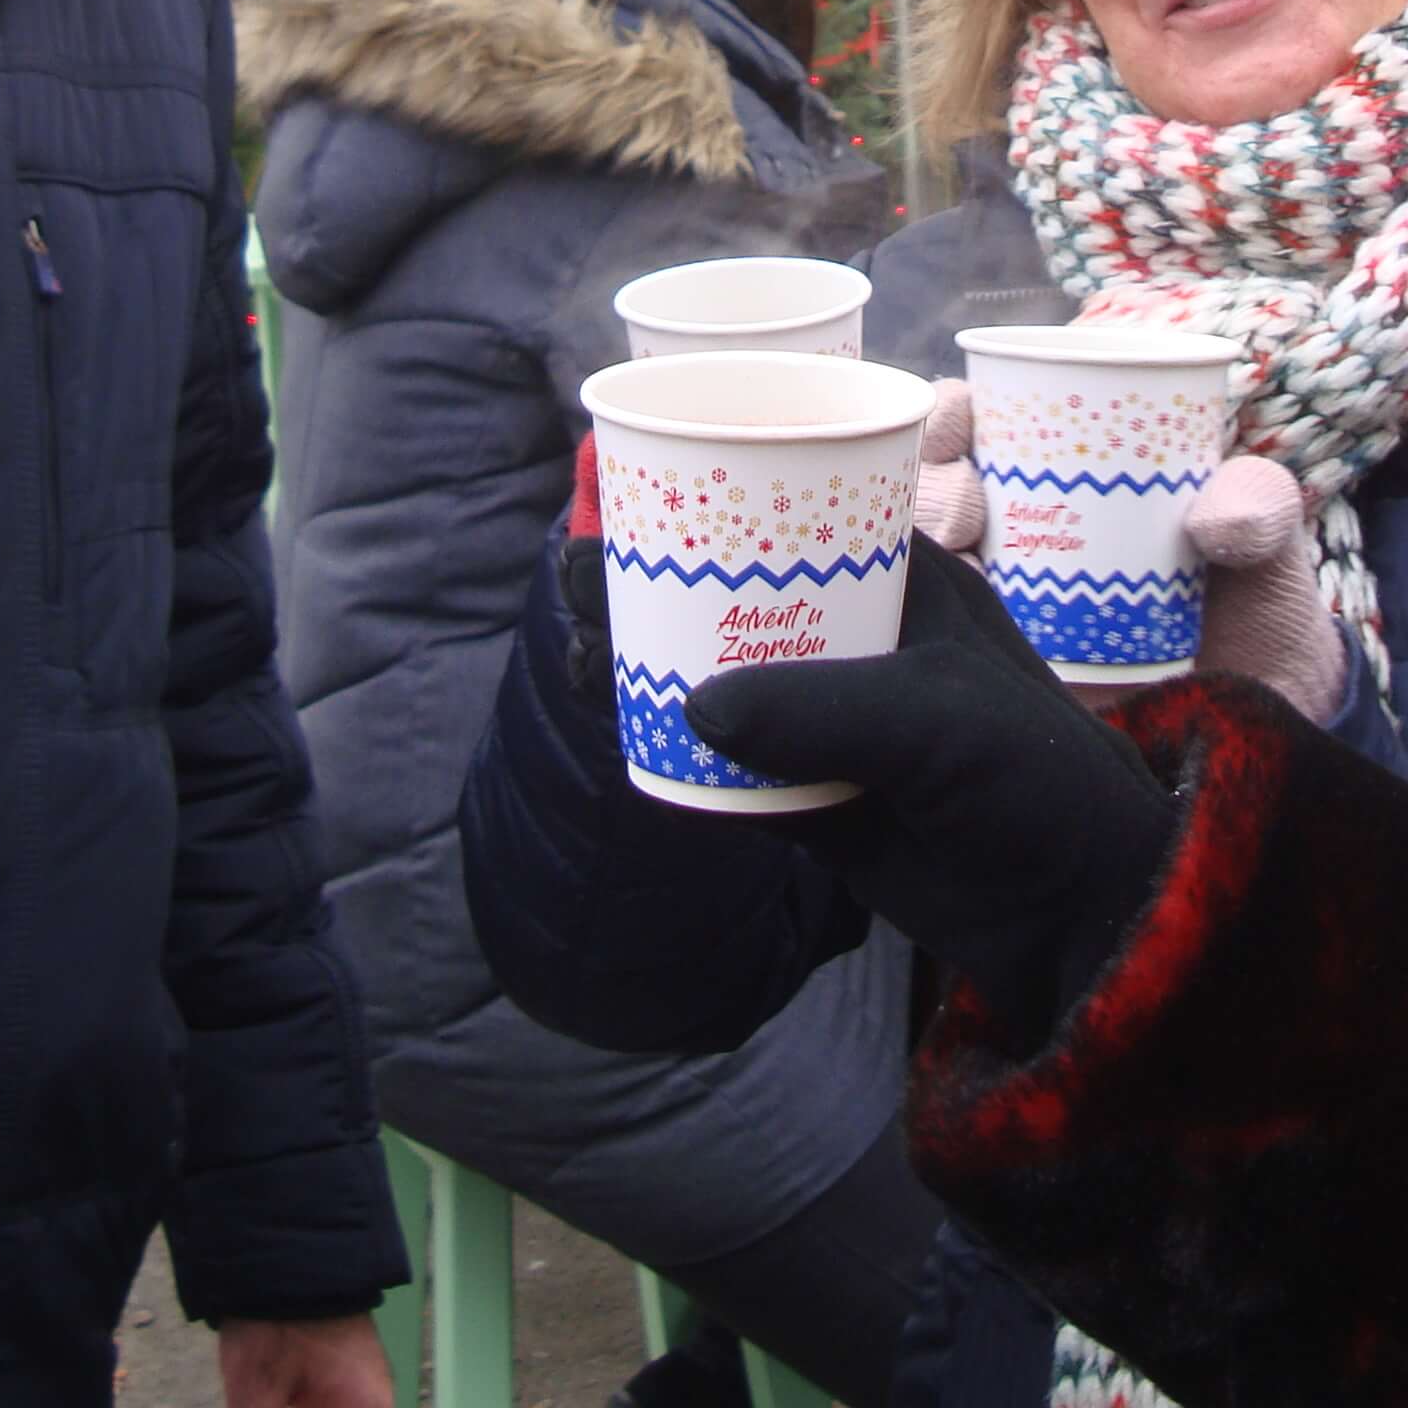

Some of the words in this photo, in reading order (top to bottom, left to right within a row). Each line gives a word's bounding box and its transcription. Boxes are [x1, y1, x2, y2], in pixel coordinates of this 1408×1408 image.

[715, 597, 809, 633] Advent
[807, 607, 824, 626] u
[716, 630, 827, 669] Zagrebu
